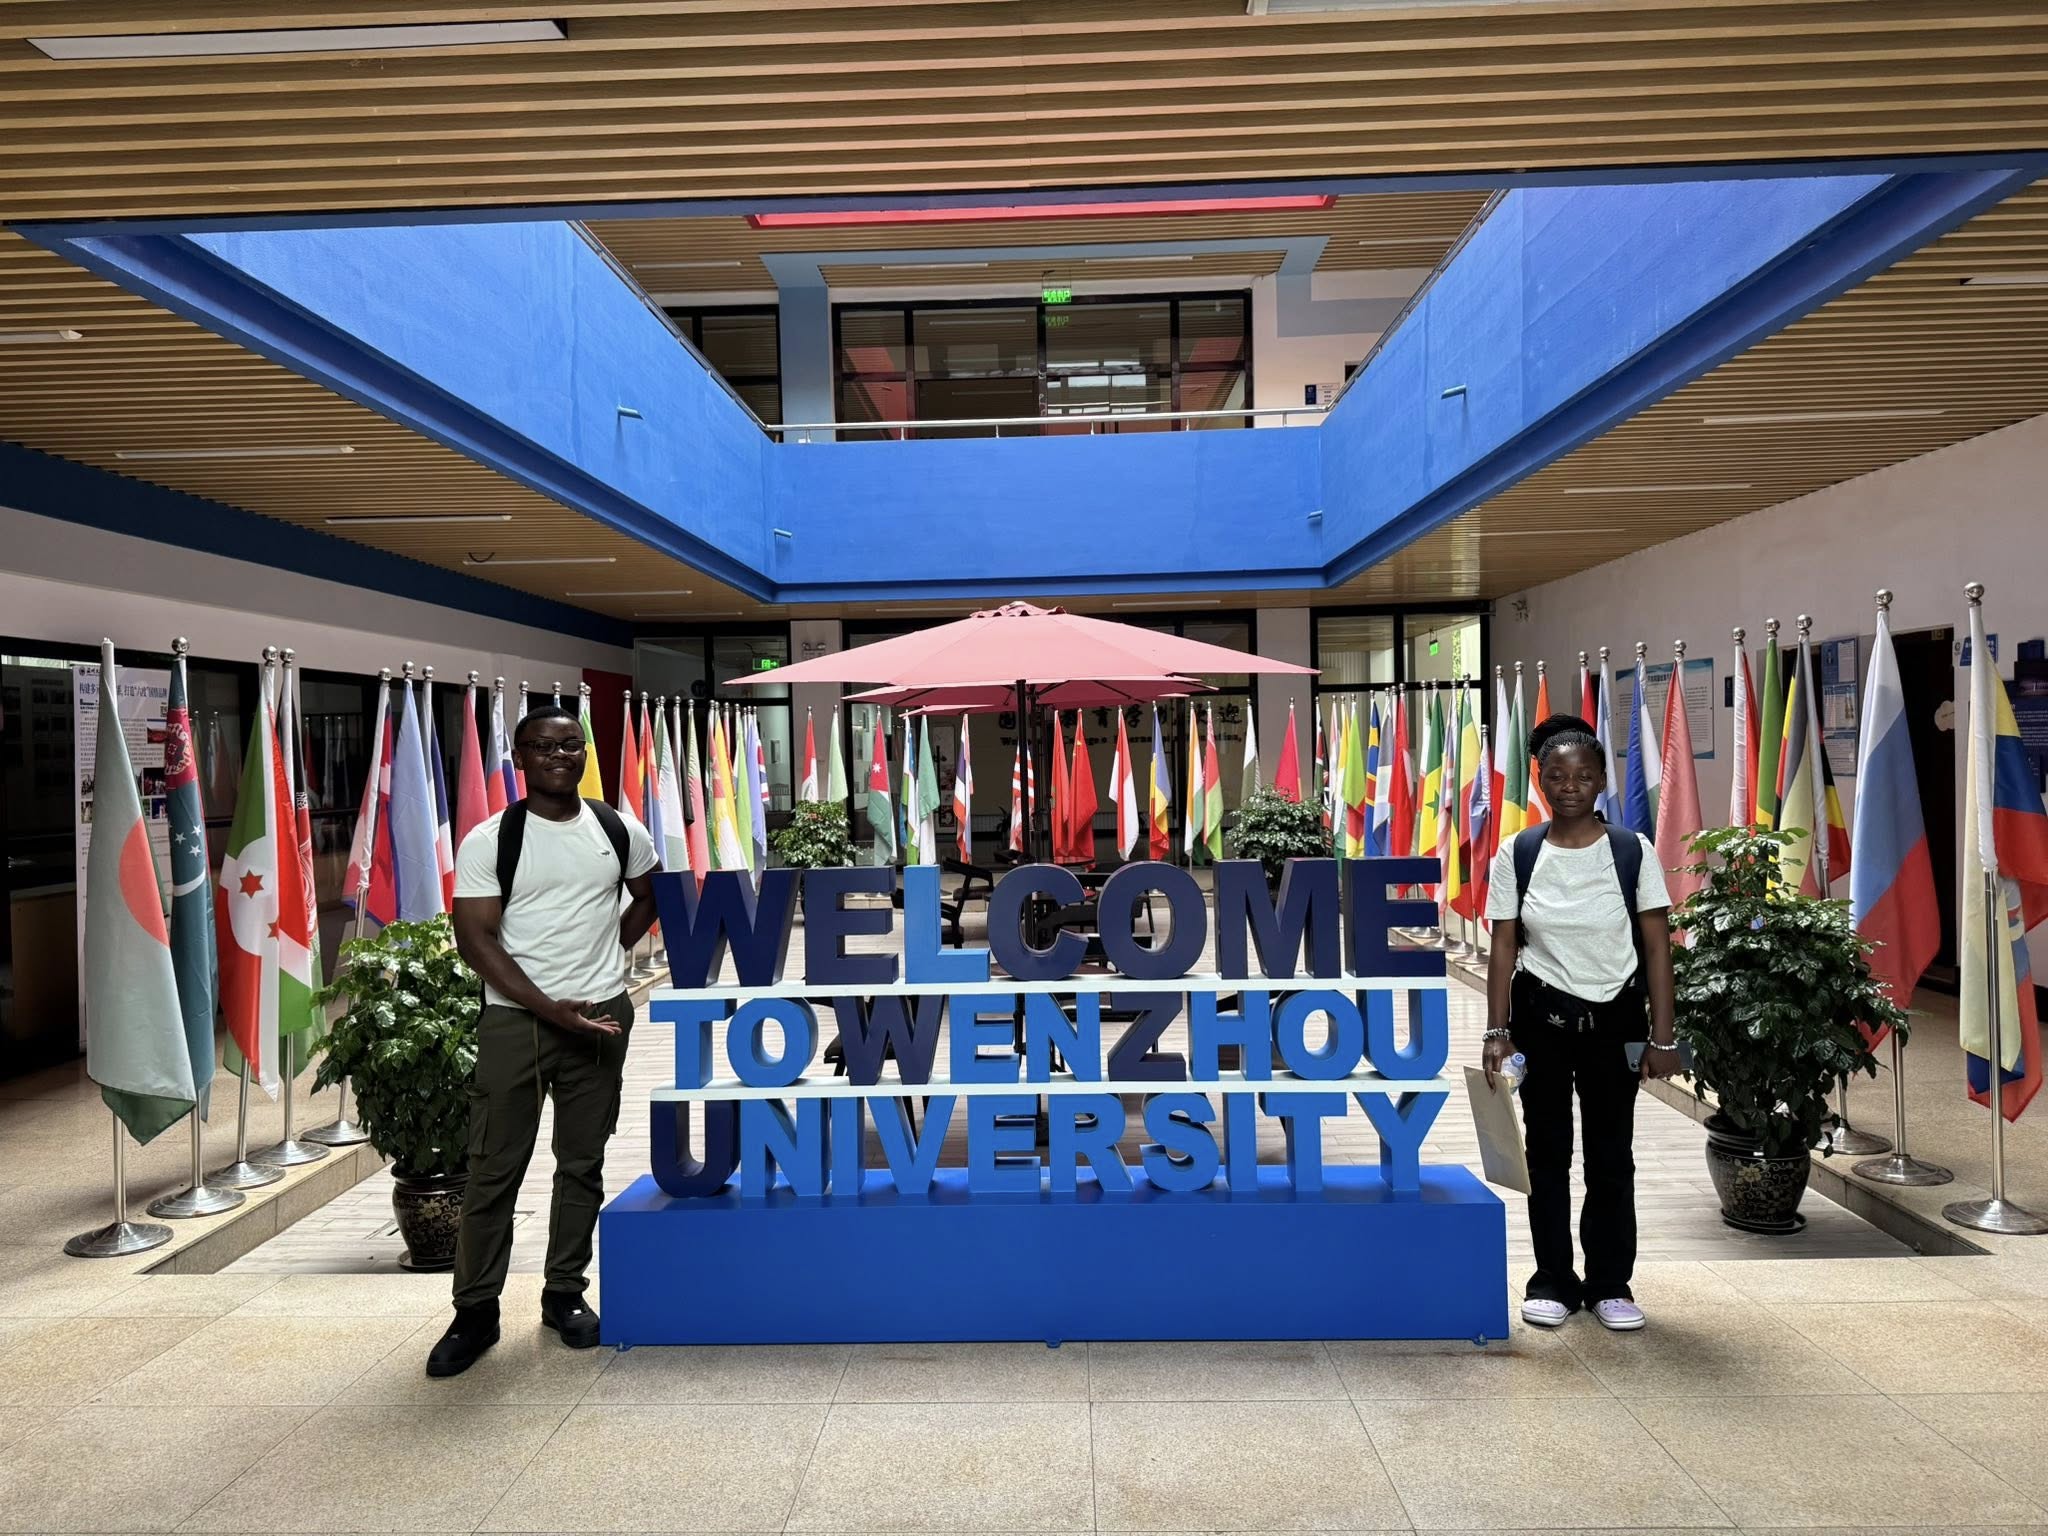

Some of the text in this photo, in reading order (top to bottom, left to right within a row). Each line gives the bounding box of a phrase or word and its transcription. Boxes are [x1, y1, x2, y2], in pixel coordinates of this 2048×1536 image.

[650, 857, 1447, 988] WELCOME
[650, 988, 1449, 1090] TO WENZHOU
[650, 1091, 1450, 1198] UNIVERSITY
